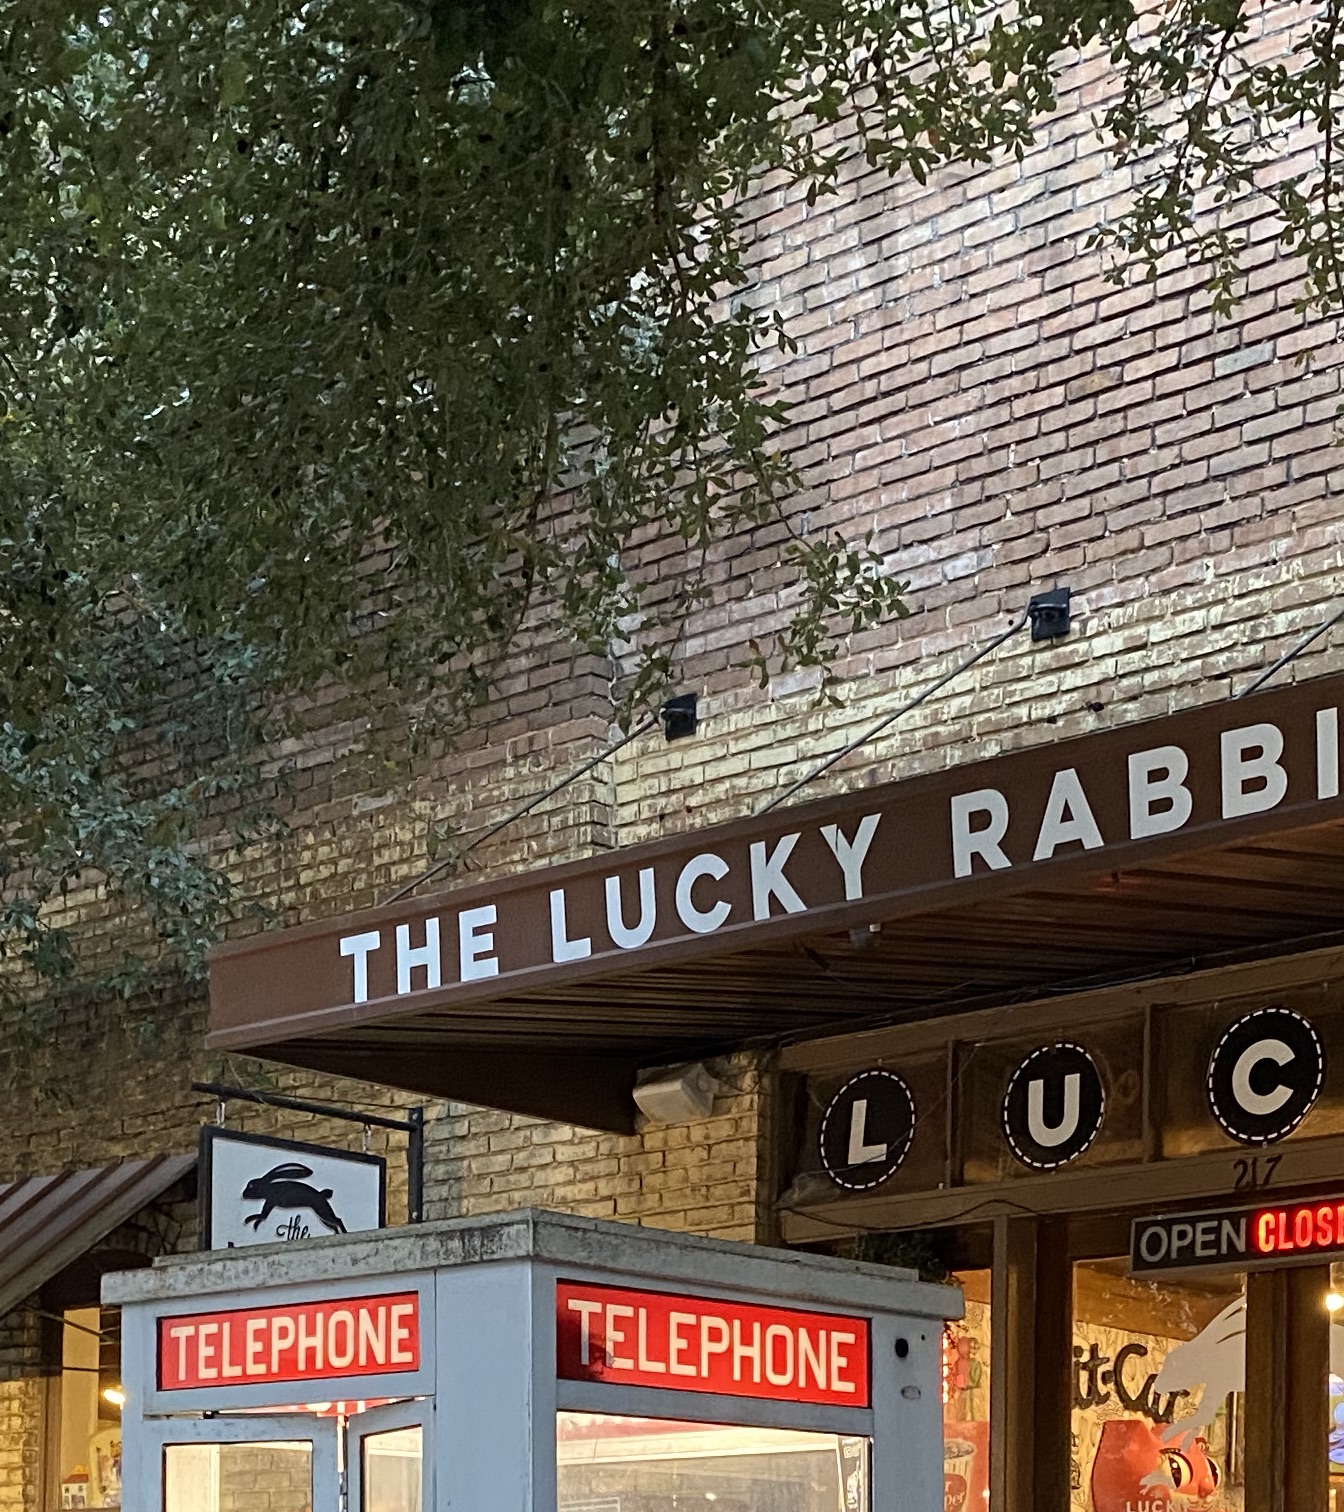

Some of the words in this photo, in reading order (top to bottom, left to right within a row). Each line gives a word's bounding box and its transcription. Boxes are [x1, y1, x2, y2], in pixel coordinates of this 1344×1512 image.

[340, 907, 499, 1003] THE
[549, 815, 882, 963] LUCKY
[1233, 1153, 1283, 1190] 217
[1140, 1217, 1247, 1263] OPEN
[170, 1303, 414, 1382] TELEPHONE
[567, 1299, 858, 1394] TELEPHONE
